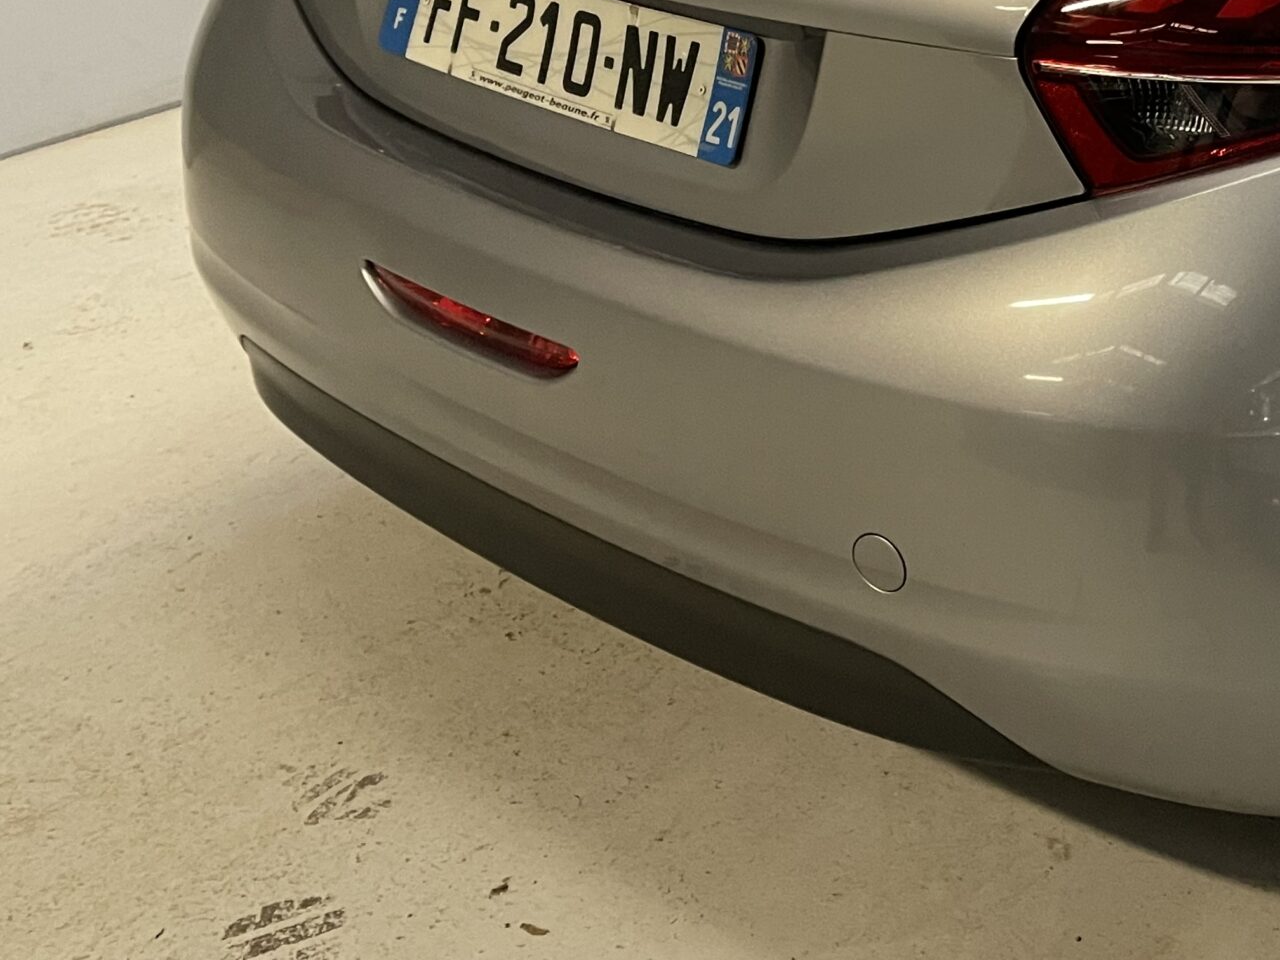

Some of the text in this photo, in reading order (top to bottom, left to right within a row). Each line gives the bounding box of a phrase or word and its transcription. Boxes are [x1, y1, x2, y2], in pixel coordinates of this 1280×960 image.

[393, 7, 407, 29] F
[479, 75, 600, 122] www.peugeot-beaune.fr
[705, 101, 741, 149] 21
